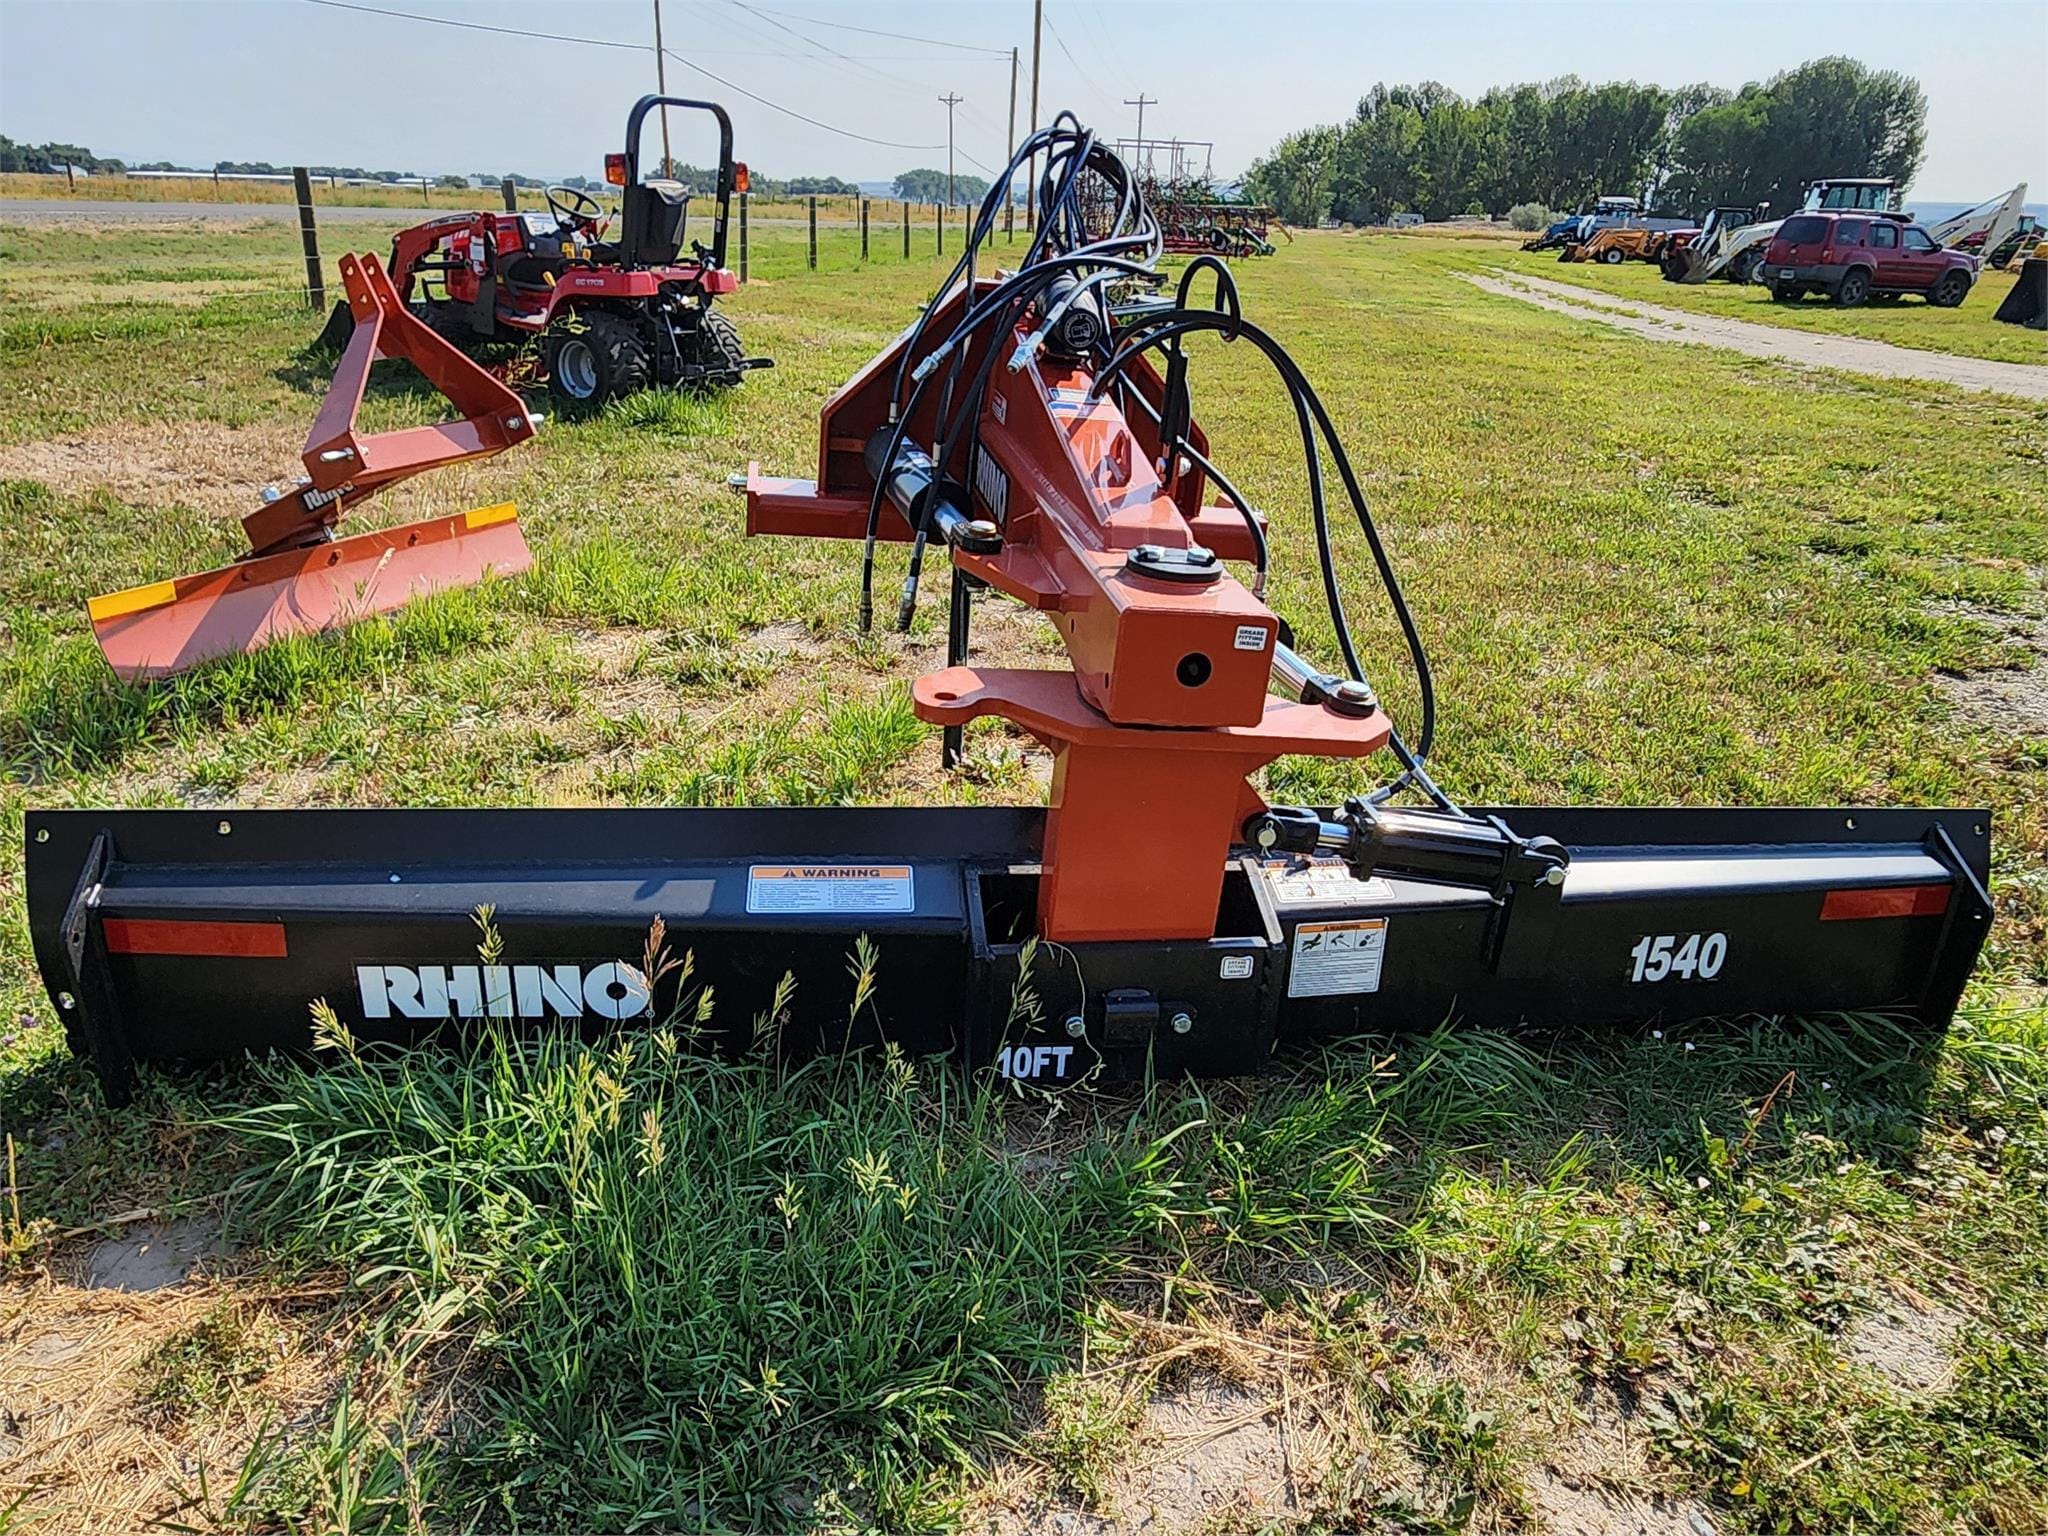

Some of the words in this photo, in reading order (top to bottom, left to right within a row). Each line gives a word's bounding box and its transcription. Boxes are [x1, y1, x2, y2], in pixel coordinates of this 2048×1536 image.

[976, 443, 1007, 525] RHINO
[802, 869, 881, 878] WARNING
[1631, 932, 1728, 983] 1540
[356, 961, 651, 1020] RHINO
[997, 1046, 1074, 1079] 10FT
